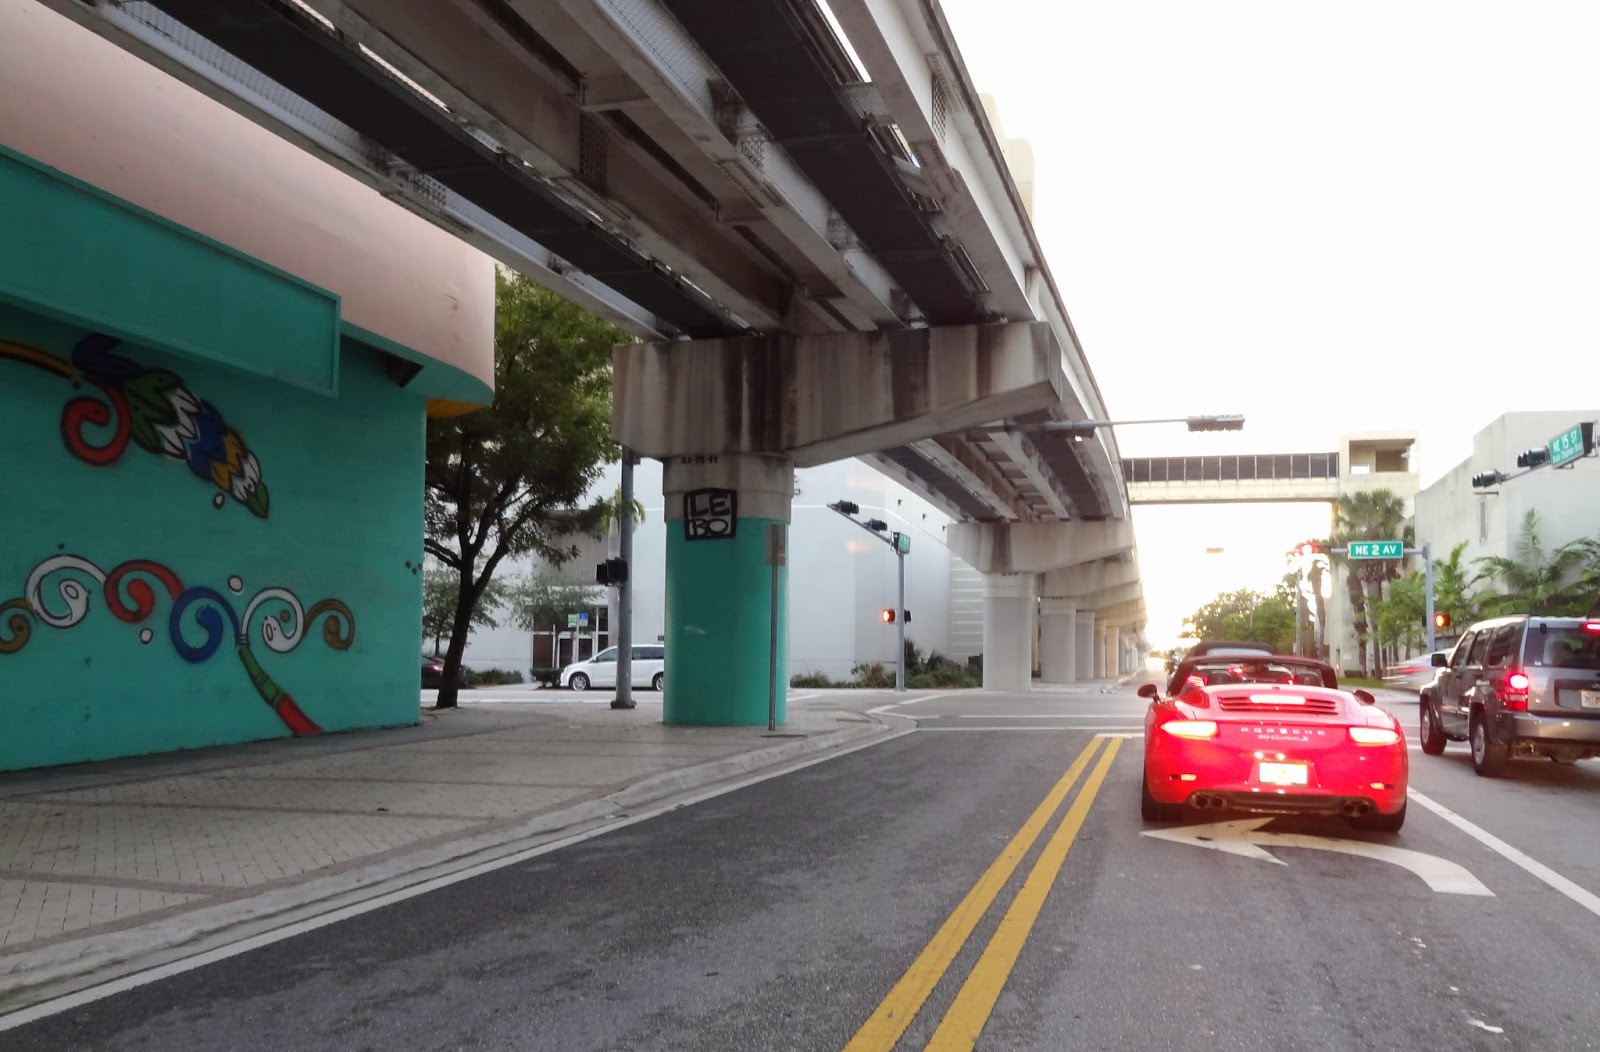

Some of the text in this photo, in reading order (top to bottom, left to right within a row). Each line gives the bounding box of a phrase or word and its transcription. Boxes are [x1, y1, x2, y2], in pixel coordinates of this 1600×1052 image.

[1553, 439, 1561, 453] NE
[1561, 433, 1569, 450] 15
[1570, 429, 1578, 444] ST
[689, 492, 730, 517] LE
[689, 518, 729, 537] BO
[1355, 544, 1397, 556] NE 2 AV
